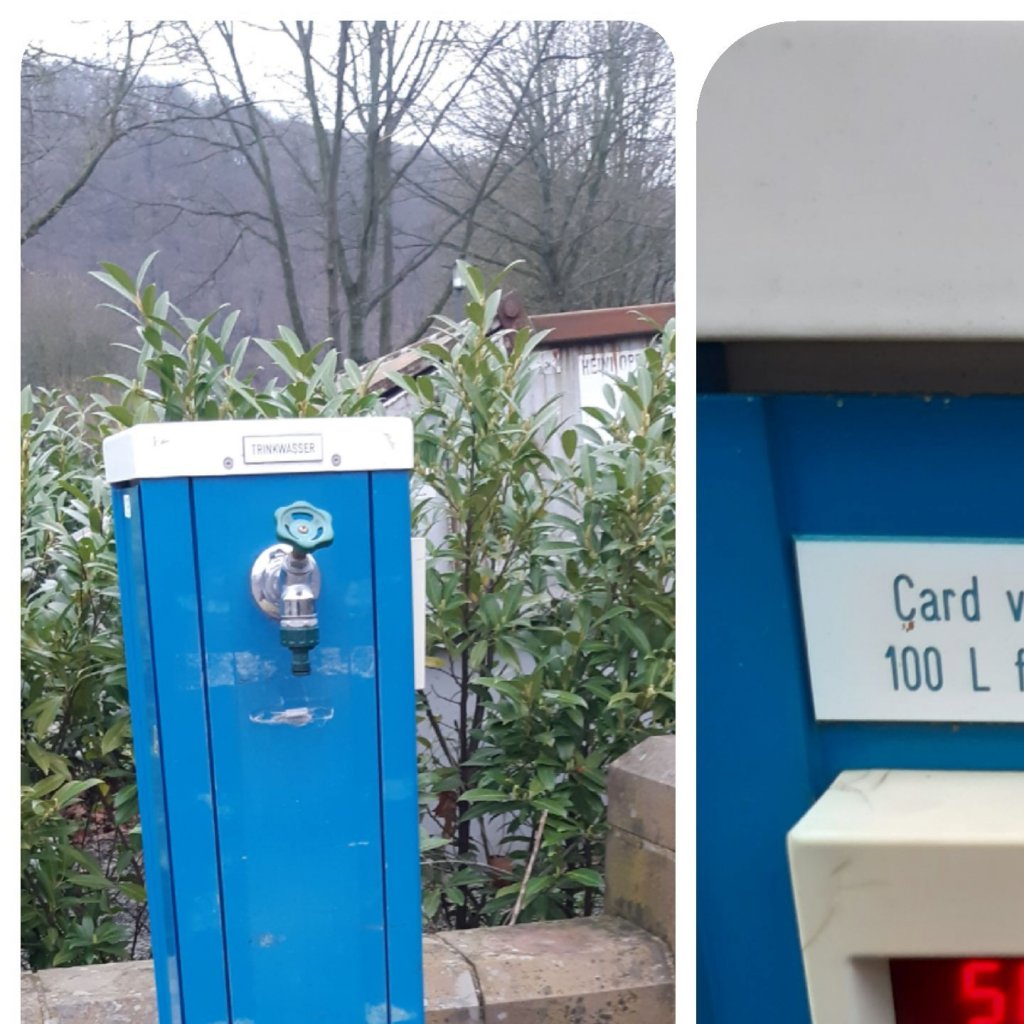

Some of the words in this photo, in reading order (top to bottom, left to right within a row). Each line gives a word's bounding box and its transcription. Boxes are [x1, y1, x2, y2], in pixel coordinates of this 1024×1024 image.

[251, 443, 315, 455] TRINKWASSER
[892, 574, 981, 622] Card
[884, 645, 944, 692] 100
[969, 647, 991, 692] L
